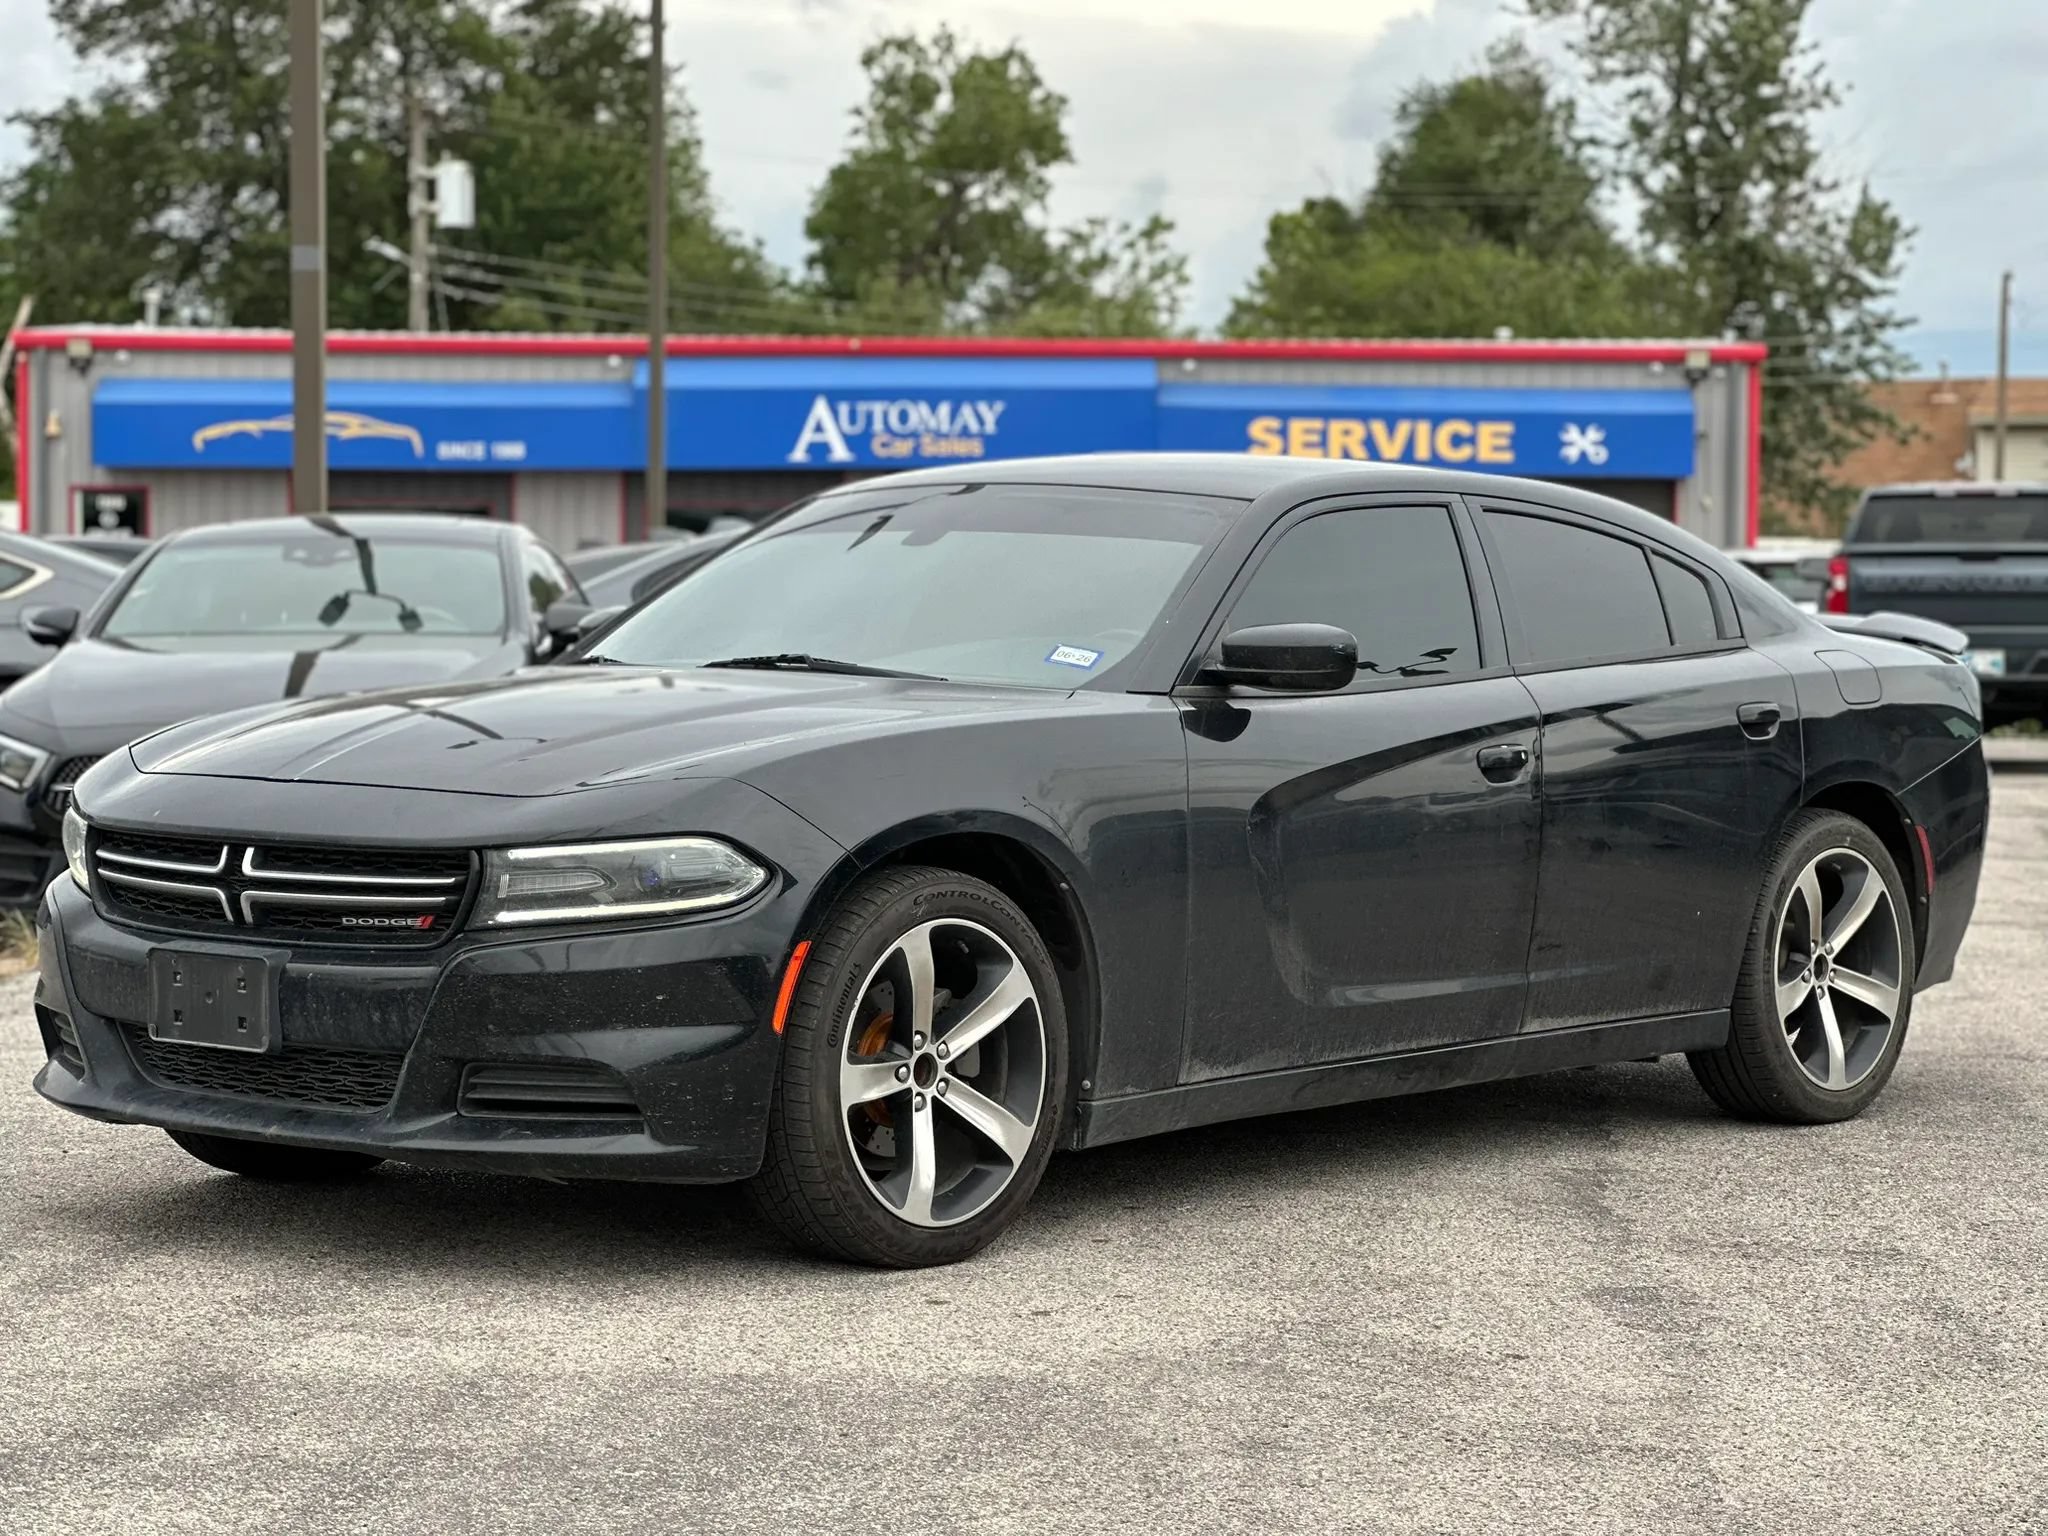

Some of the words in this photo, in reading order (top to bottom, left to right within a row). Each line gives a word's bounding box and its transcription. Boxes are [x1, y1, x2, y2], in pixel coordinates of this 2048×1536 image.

[788, 395, 1005, 462] AUTOMAY
[872, 434, 916, 458] Car
[1246, 416, 1515, 463] SERVICE
[341, 917, 422, 927] DODGE
